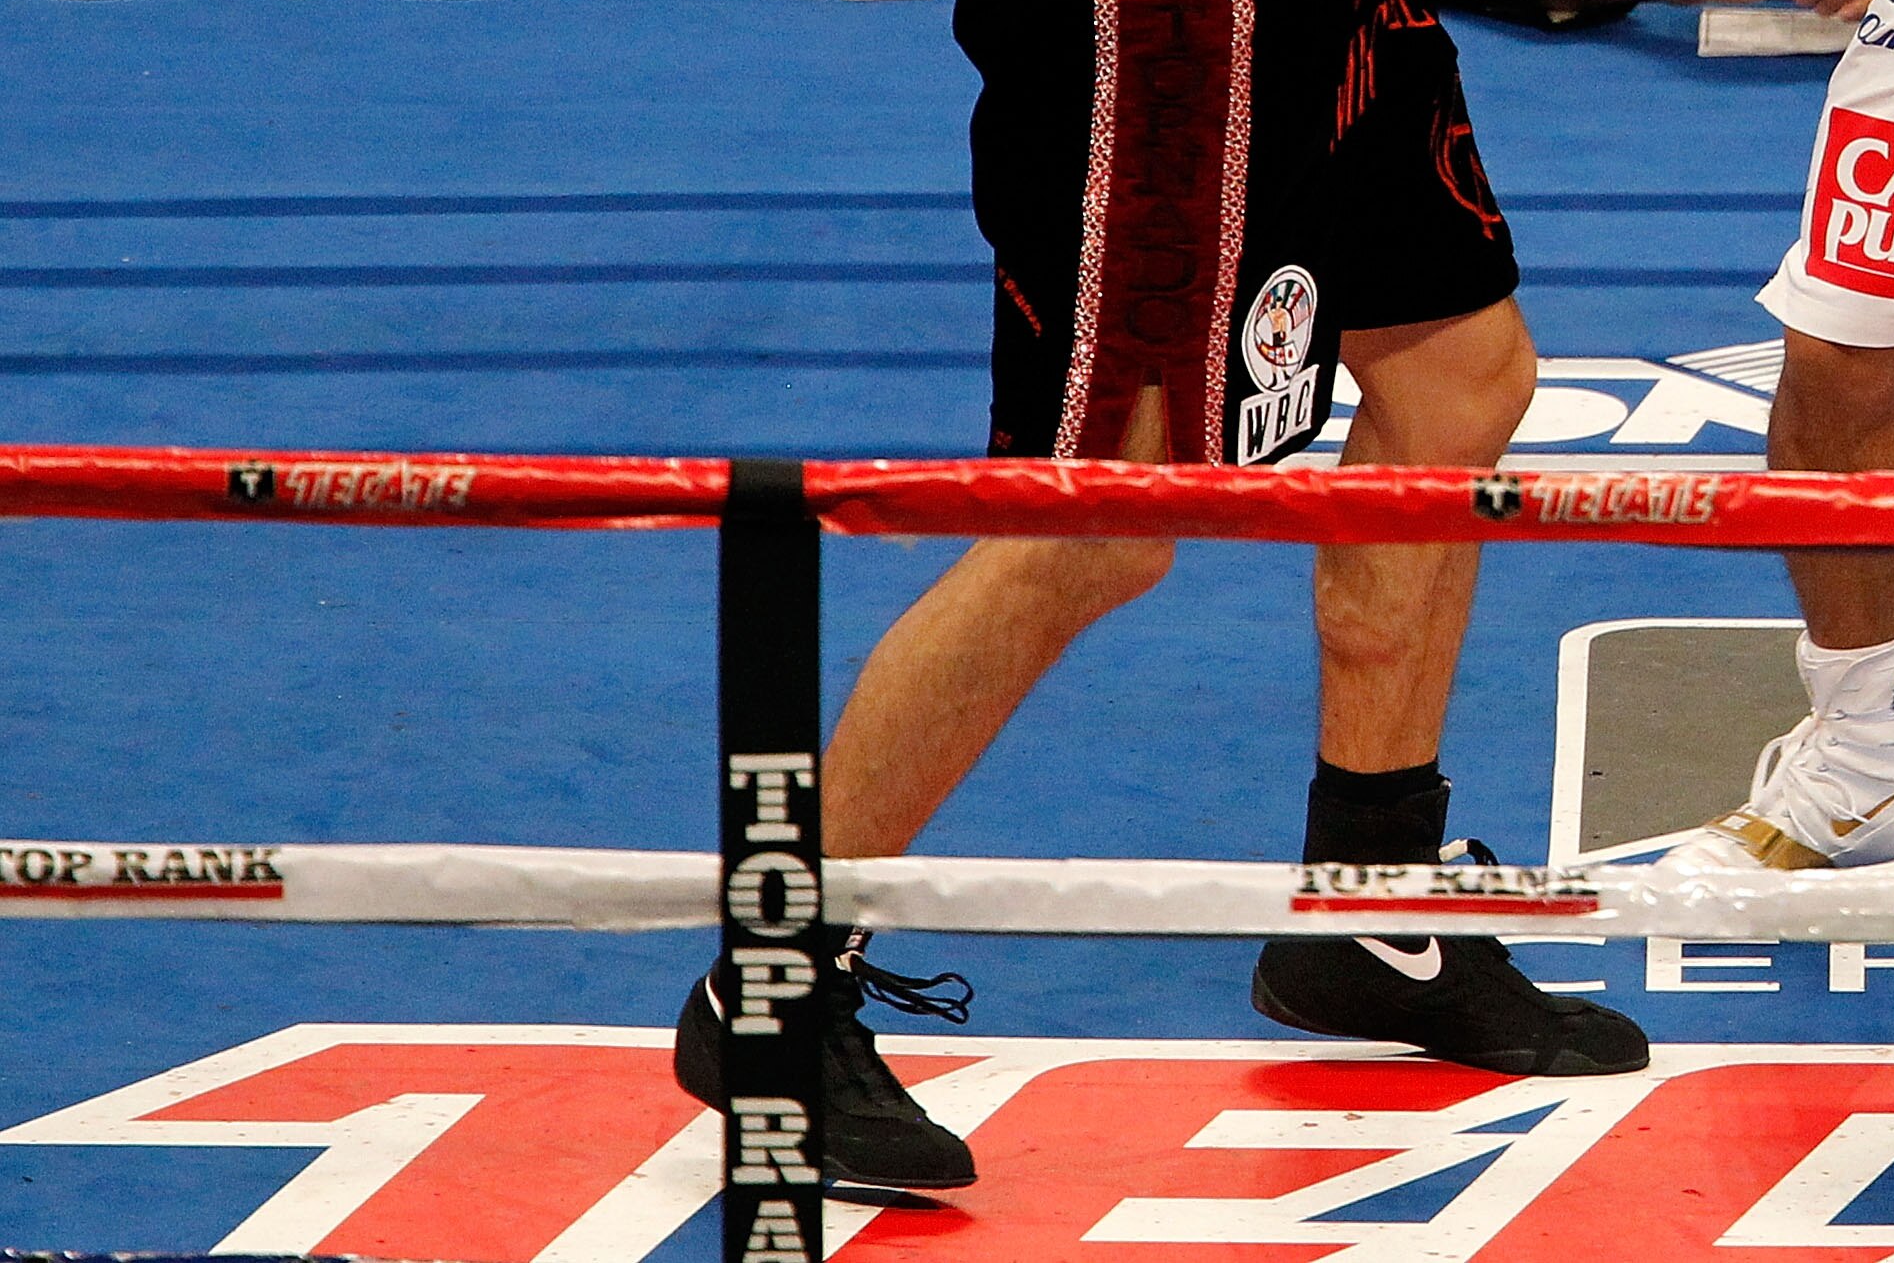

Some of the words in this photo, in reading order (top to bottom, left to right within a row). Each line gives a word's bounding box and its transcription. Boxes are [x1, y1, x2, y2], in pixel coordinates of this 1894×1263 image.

[1246, 379, 1311, 458] WBC
[1531, 474, 1719, 523] TECATE
[111, 849, 283, 886] RANK
[728, 751, 820, 1036] TOP
